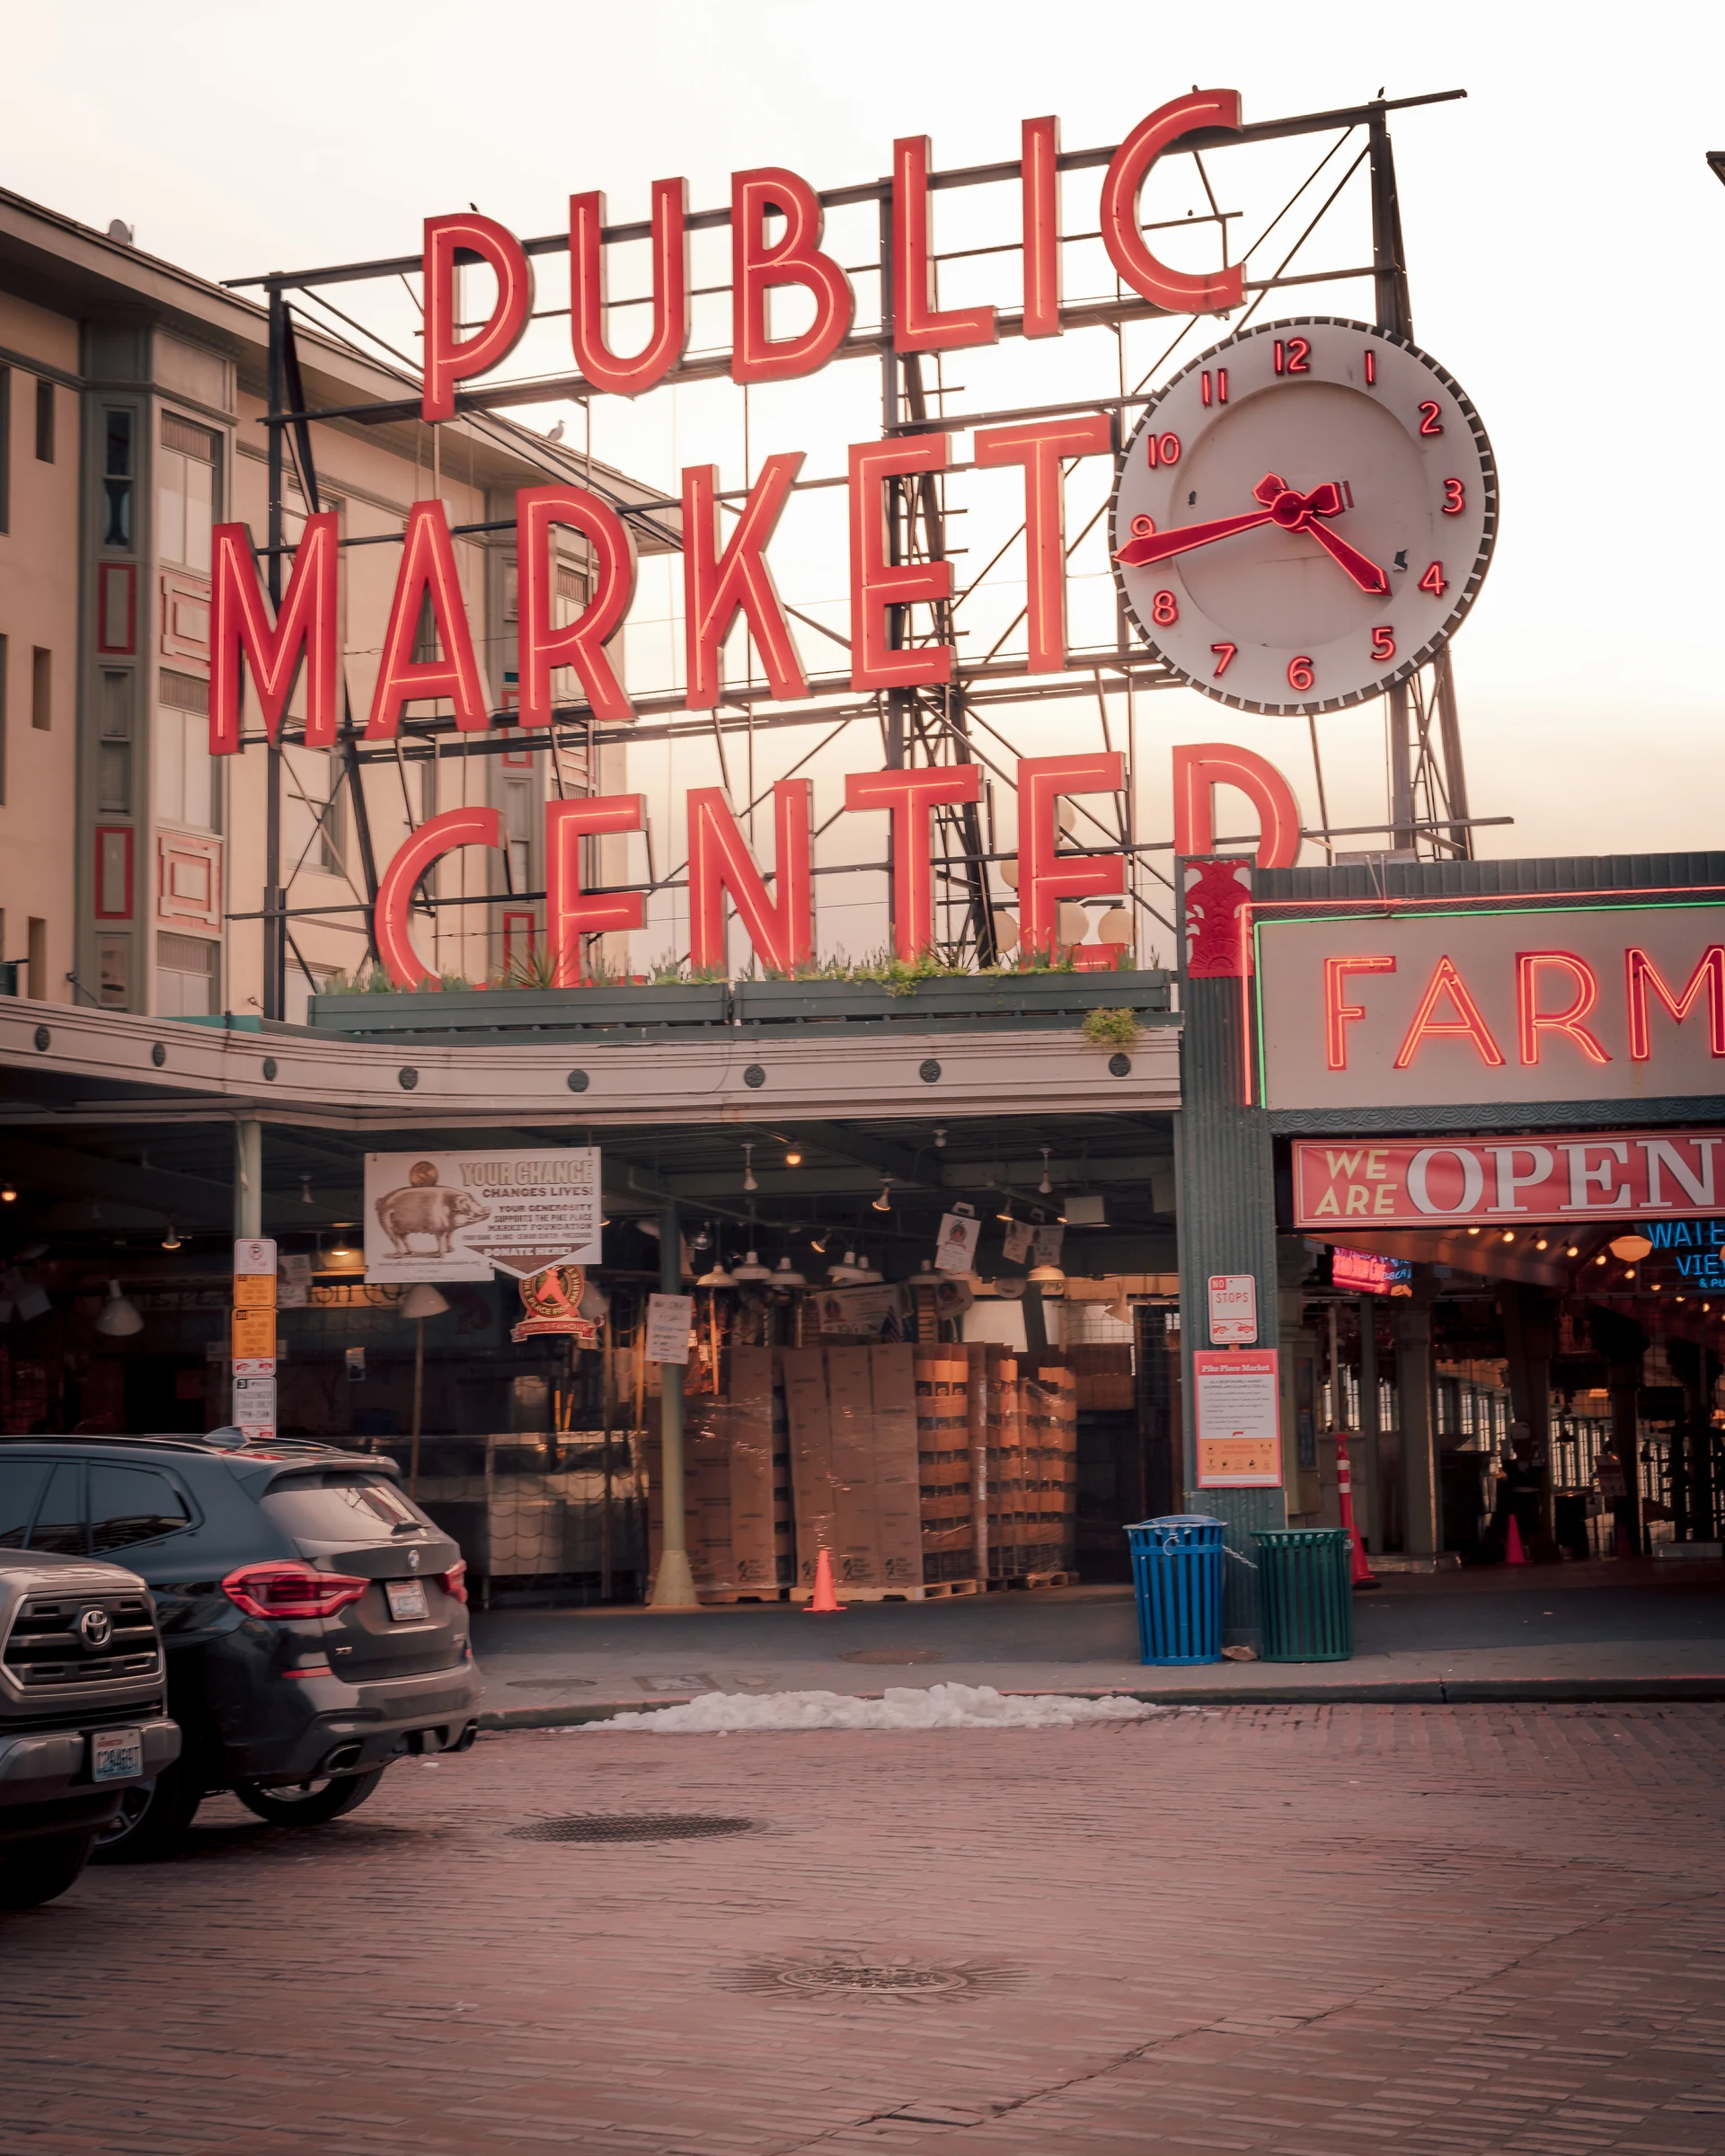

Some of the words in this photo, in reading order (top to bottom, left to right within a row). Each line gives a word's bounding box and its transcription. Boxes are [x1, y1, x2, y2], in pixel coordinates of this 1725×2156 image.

[421, 88, 1247, 421] PUBLIC
[1273, 336, 1311, 375] 12
[1365, 349, 1376, 385] 1
[1200, 367, 1229, 407] 11
[1419, 400, 1444, 436] 2
[1147, 431, 1180, 469] 10
[1441, 477, 1465, 515] 3
[1130, 513, 1156, 539] 9
[209, 412, 1116, 754] MARKET
[1419, 561, 1449, 596] 4
[1152, 589, 1179, 626] 8
[1210, 641, 1238, 677] 7
[1371, 625, 1396, 661] 5
[1287, 655, 1314, 691] 6
[1324, 945, 1725, 1071] FARM
[459, 1162, 513, 1187] YOUR
[516, 1160, 593, 1185] CHANGE
[1324, 1149, 1390, 1180] WE
[1406, 1137, 1722, 1215] OPEN
[482, 1187, 546, 1197] CHANGES
[551, 1186, 593, 1197] LIVES!
[499, 1205, 526, 1213] YOUR
[1314, 1183, 1398, 1216] ARE
[483, 1248, 534, 1257] DONATE
[1676, 1253, 1725, 1276] VIE
[1212, 1279, 1225, 1289] NO
[1216, 1292, 1249, 1303] STOPS
[1201, 1365, 1219, 1373] Pike
[1242, 1364, 1270, 1372] Market
